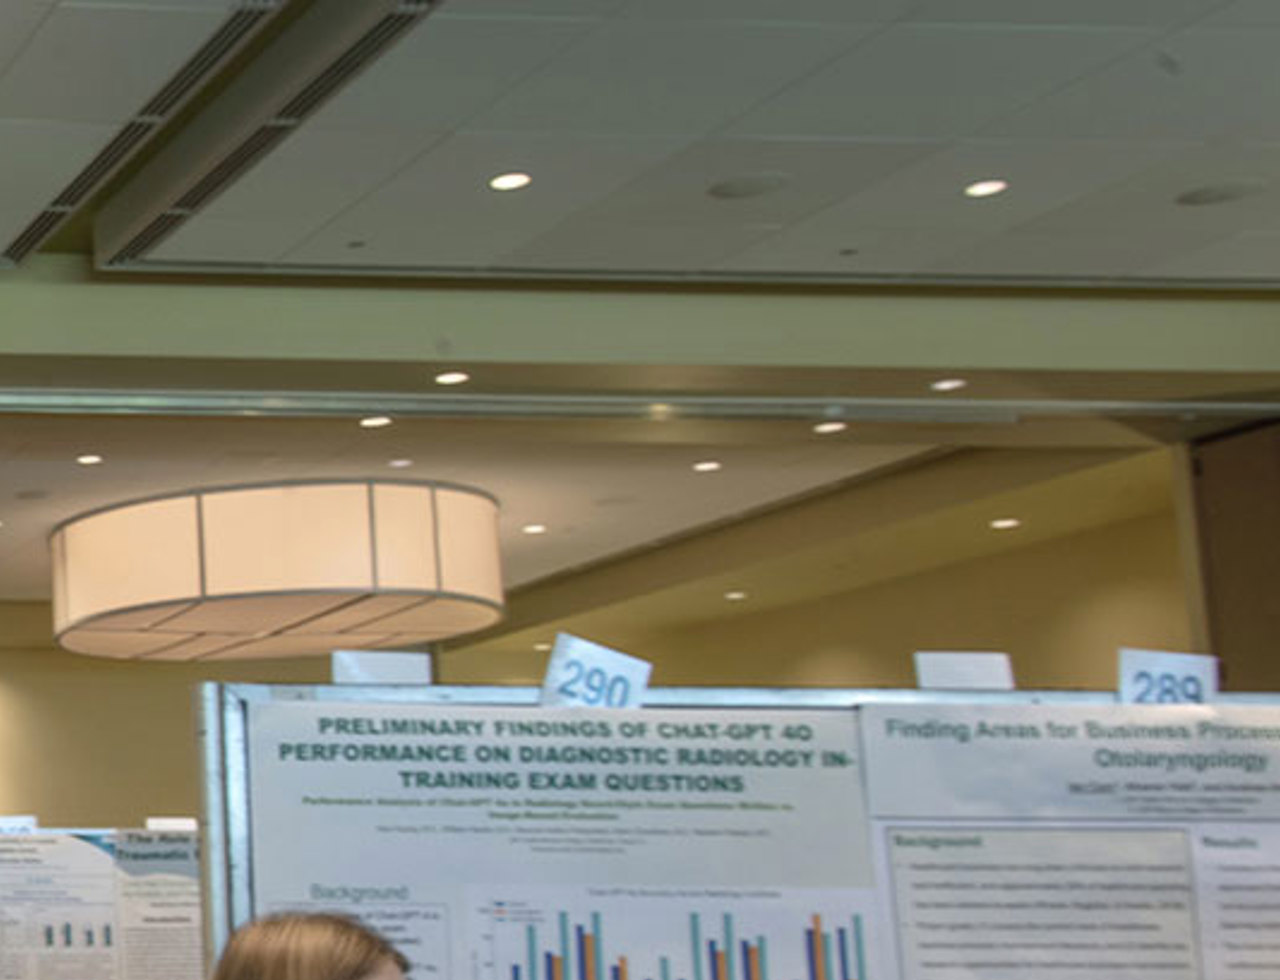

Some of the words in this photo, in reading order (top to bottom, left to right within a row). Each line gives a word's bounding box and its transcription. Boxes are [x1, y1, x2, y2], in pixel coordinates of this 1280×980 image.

[558, 660, 630, 708] 290
[317, 716, 486, 736] PRELIMINARY
[493, 719, 613, 739] FINDINGS
[618, 722, 648, 738] OF
[657, 722, 774, 741] CHAT-GPT
[885, 718, 971, 742] Finding
[974, 721, 1041, 740] Areas
[1047, 721, 1078, 739] for
[1085, 721, 1190, 741] Business
[278, 743, 468, 763] PERFORMANCE
[474, 745, 512, 763] ON
[519, 745, 669, 766] DIAGNOSTIC
[677, 748, 814, 768] RADIOLOGY
[822, 751, 854, 768] IN-
[1093, 749, 1269, 773] Otolaryngology
[398, 769, 521, 789] TRAINING
[528, 772, 598, 790] EXAM
[605, 773, 746, 793] QUESTIONS
[894, 834, 982, 850] Background
[309, 884, 409, 902] Background
